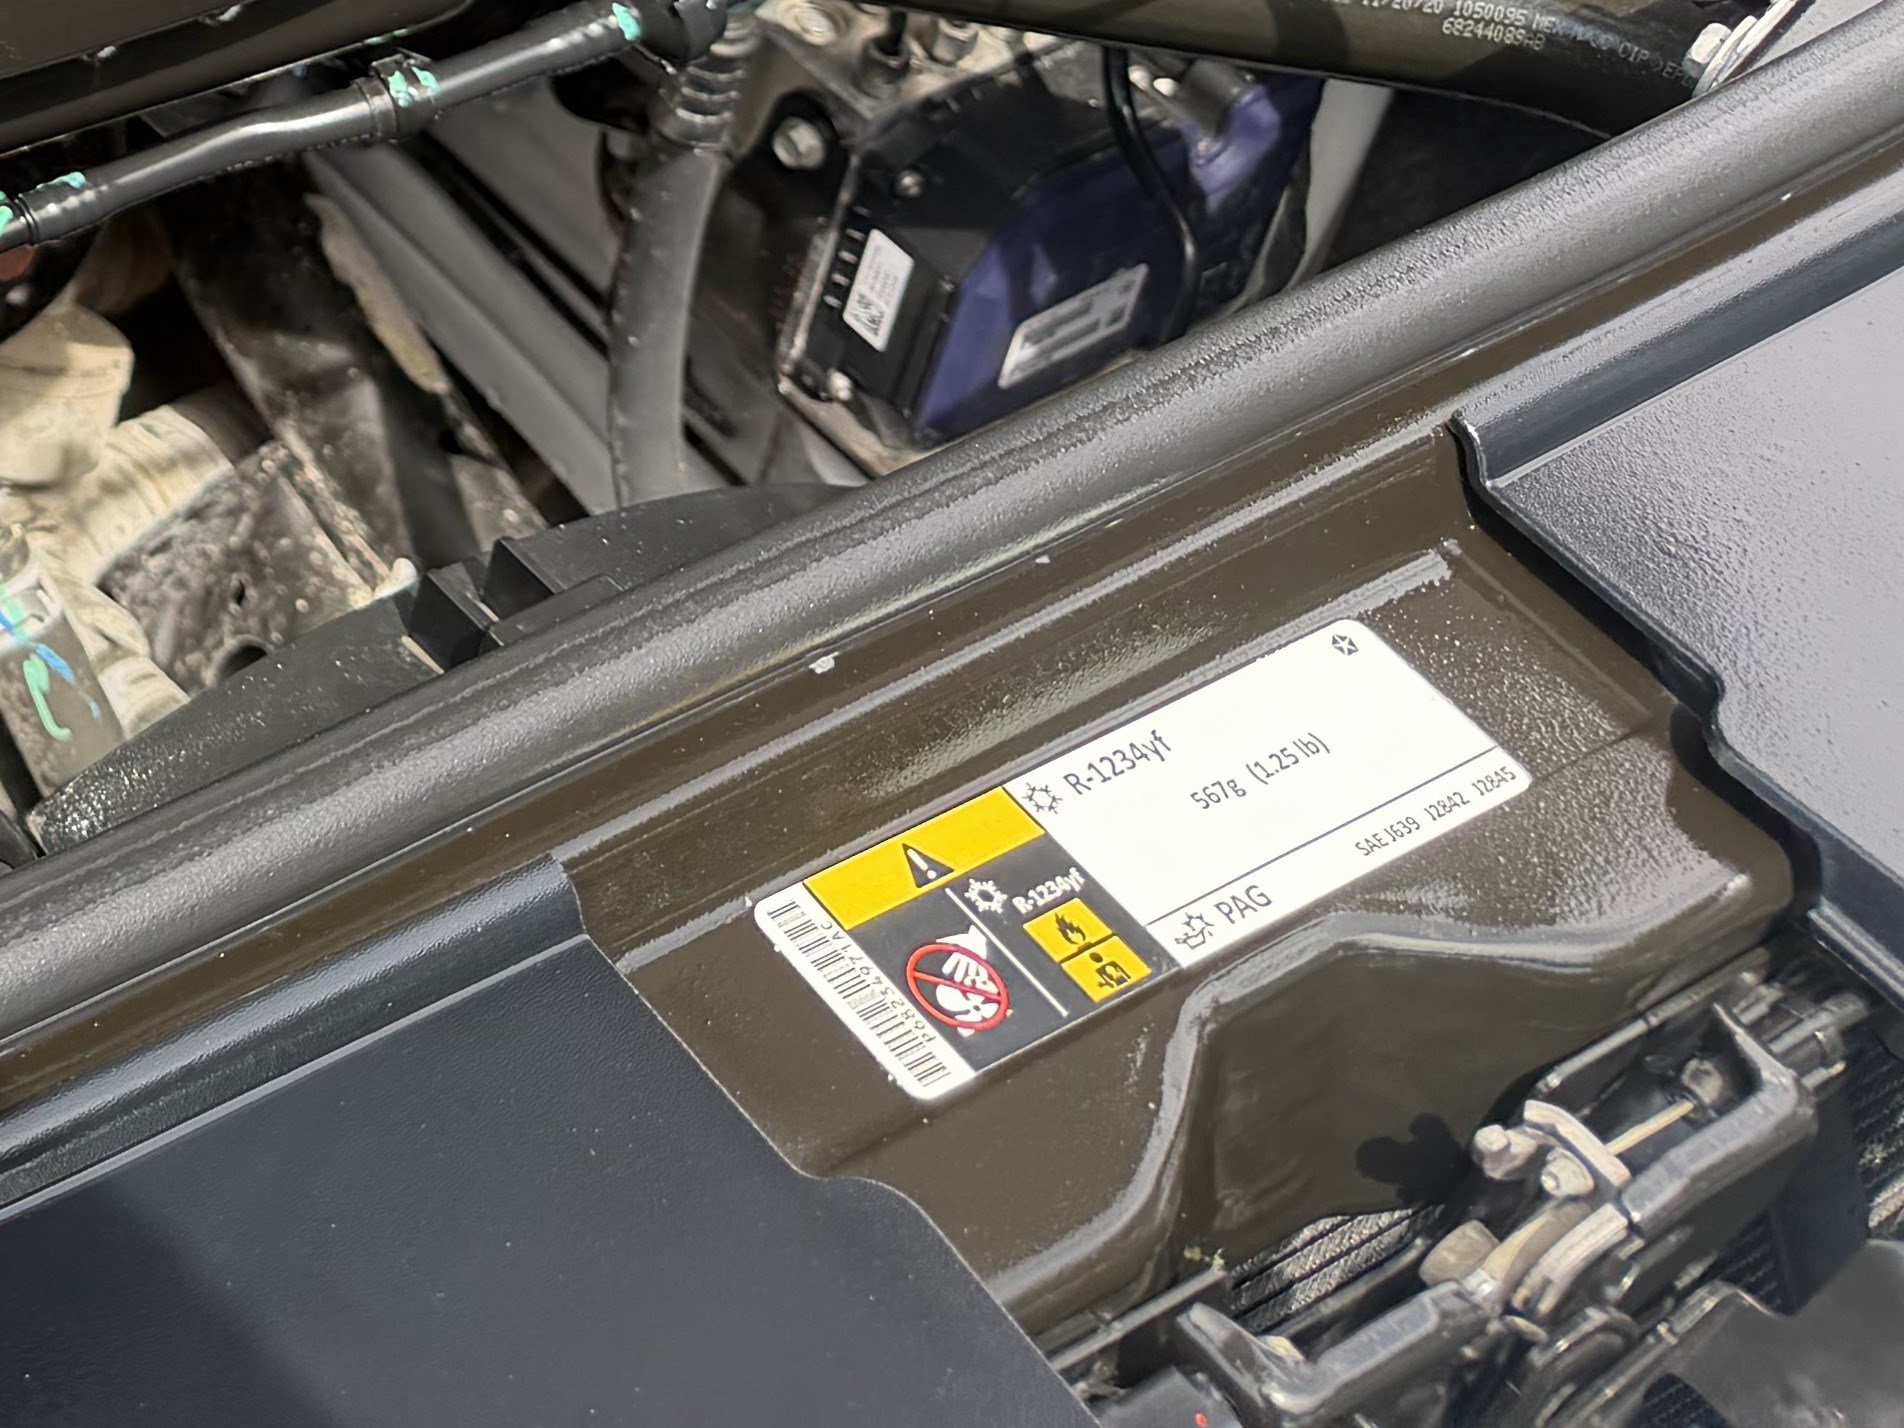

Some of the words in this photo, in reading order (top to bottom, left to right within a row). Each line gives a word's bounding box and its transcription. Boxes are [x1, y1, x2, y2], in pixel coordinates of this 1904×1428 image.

[1062, 728, 1172, 796] R-1234yf
[1189, 778, 1247, 810] 567g
[1245, 746, 1300, 785] (1.25
[1292, 731, 1331, 759] lb)
[1423, 790, 1472, 822] J2842
[1471, 765, 1518, 797] J2845
[1011, 866, 1086, 915] R-1234yf
[1213, 884, 1274, 925] PAG
